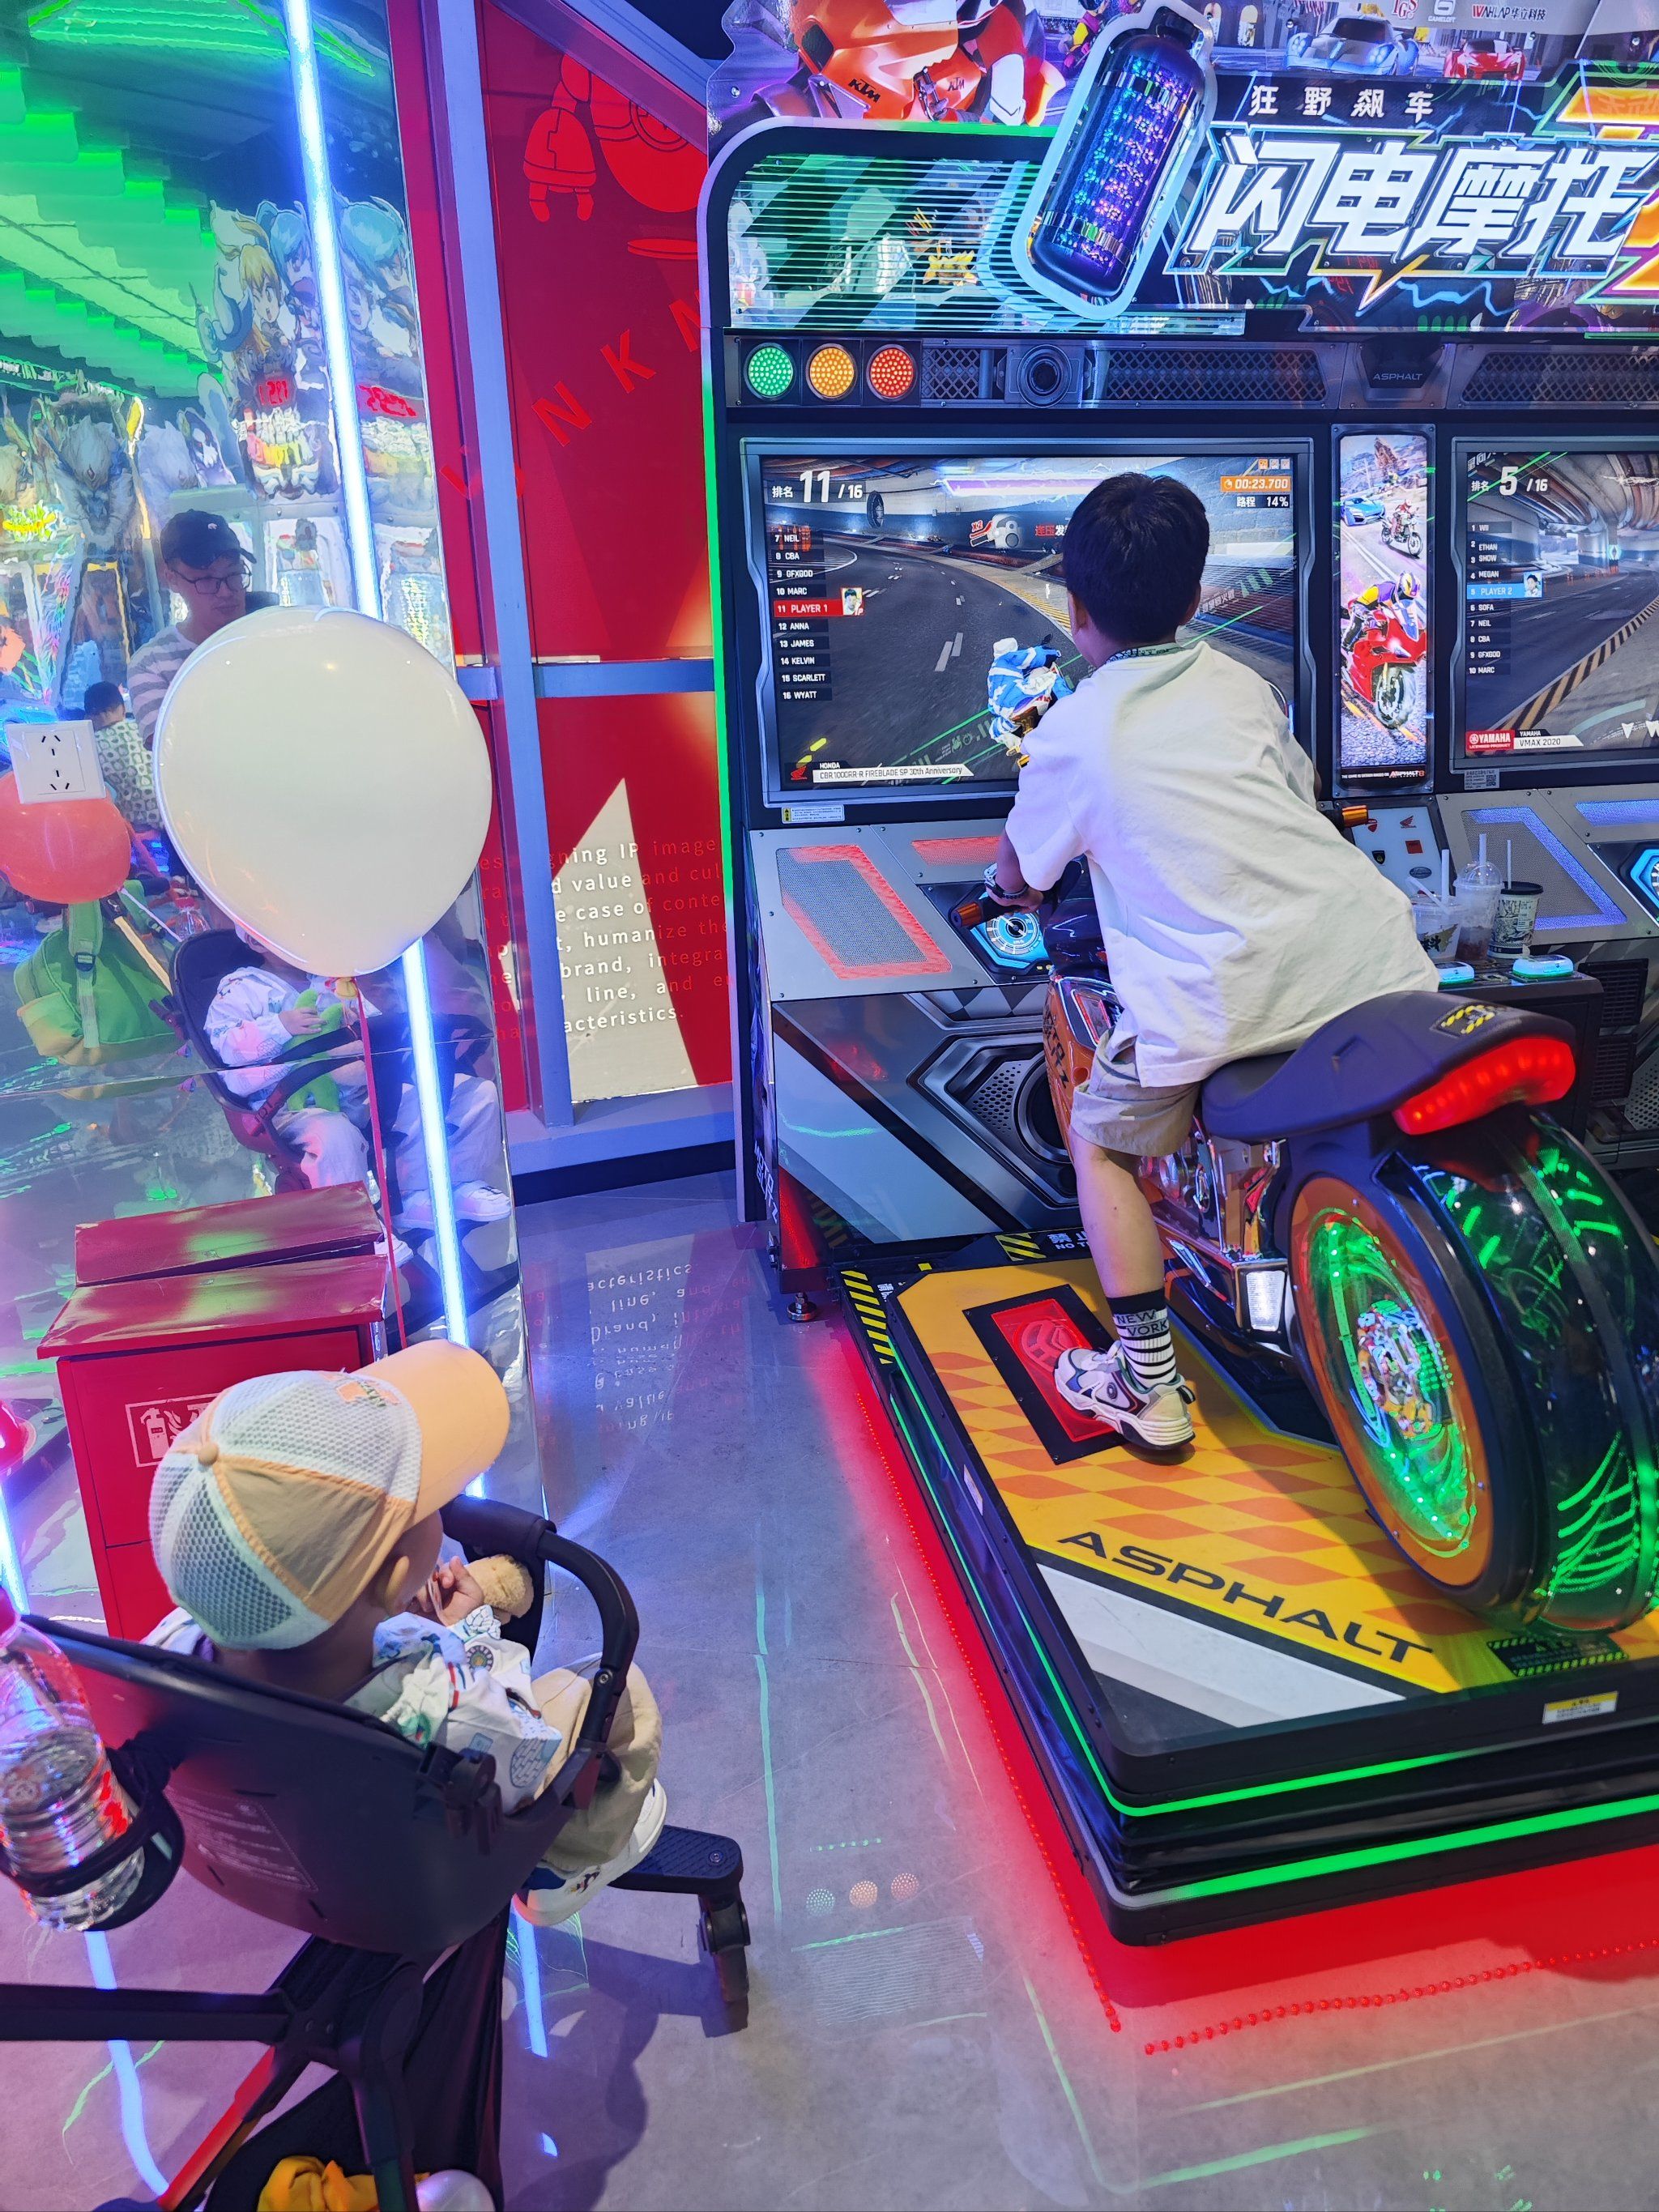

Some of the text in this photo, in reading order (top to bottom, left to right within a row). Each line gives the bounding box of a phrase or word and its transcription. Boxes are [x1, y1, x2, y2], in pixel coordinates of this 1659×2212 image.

[1511, 7, 1546, 21] 华立科技
[848, 79, 881, 103] KTM
[1248, 84, 1434, 122] 狂野飙车
[1190, 134, 1658, 260] 闪电摩托
[1373, 373, 1423, 381] ASPHALT
[772, 486, 793, 498] 排名
[800, 470, 830, 502] 11
[1235, 479, 1289, 489] 00:23.700
[1499, 466, 1518, 496] 5
[1236, 496, 1289, 507] 路程 14%
[1478, 543, 1498, 551] ETHAN
[1478, 554, 1497, 562] SHOW
[787, 587, 808, 595] MARC
[1481, 587, 1506, 595] PLAYER
[778, 603, 828, 613] 11 PLAYER 1
[1478, 603, 1495, 612] SOFA
[778, 622, 810, 630] 12 ANNA
[791, 639, 815, 647] JAMES
[780, 657, 815, 665] 14 KELVIN
[1478, 666, 1495, 674] MARC
[792, 673, 826, 682] SCARLETT
[794, 691, 817, 699] WYATT
[1478, 733, 1512, 744] YAMAHA
[1520, 738, 1561, 747] VMAX 2020
[819, 761, 840, 769] HONDA
[820, 770, 834, 779] CBR
[865, 768, 898, 778] FIREBLADE
[900, 768, 908, 777] SP
[924, 766, 962, 776] Anniversary
[620, 842, 638, 859] IP
[572, 873, 632, 893] value
[642, 867, 679, 885] and
[576, 903, 624, 921] case
[633, 897, 653, 915] of
[584, 924, 687, 948] humanize
[559, 956, 631, 979] brand,
[586, 985, 637, 1004] line,
[656, 975, 693, 995] and
[1115, 1310, 1155, 1324] NEW
[1056, 1531, 1434, 1664] ASPHALT
